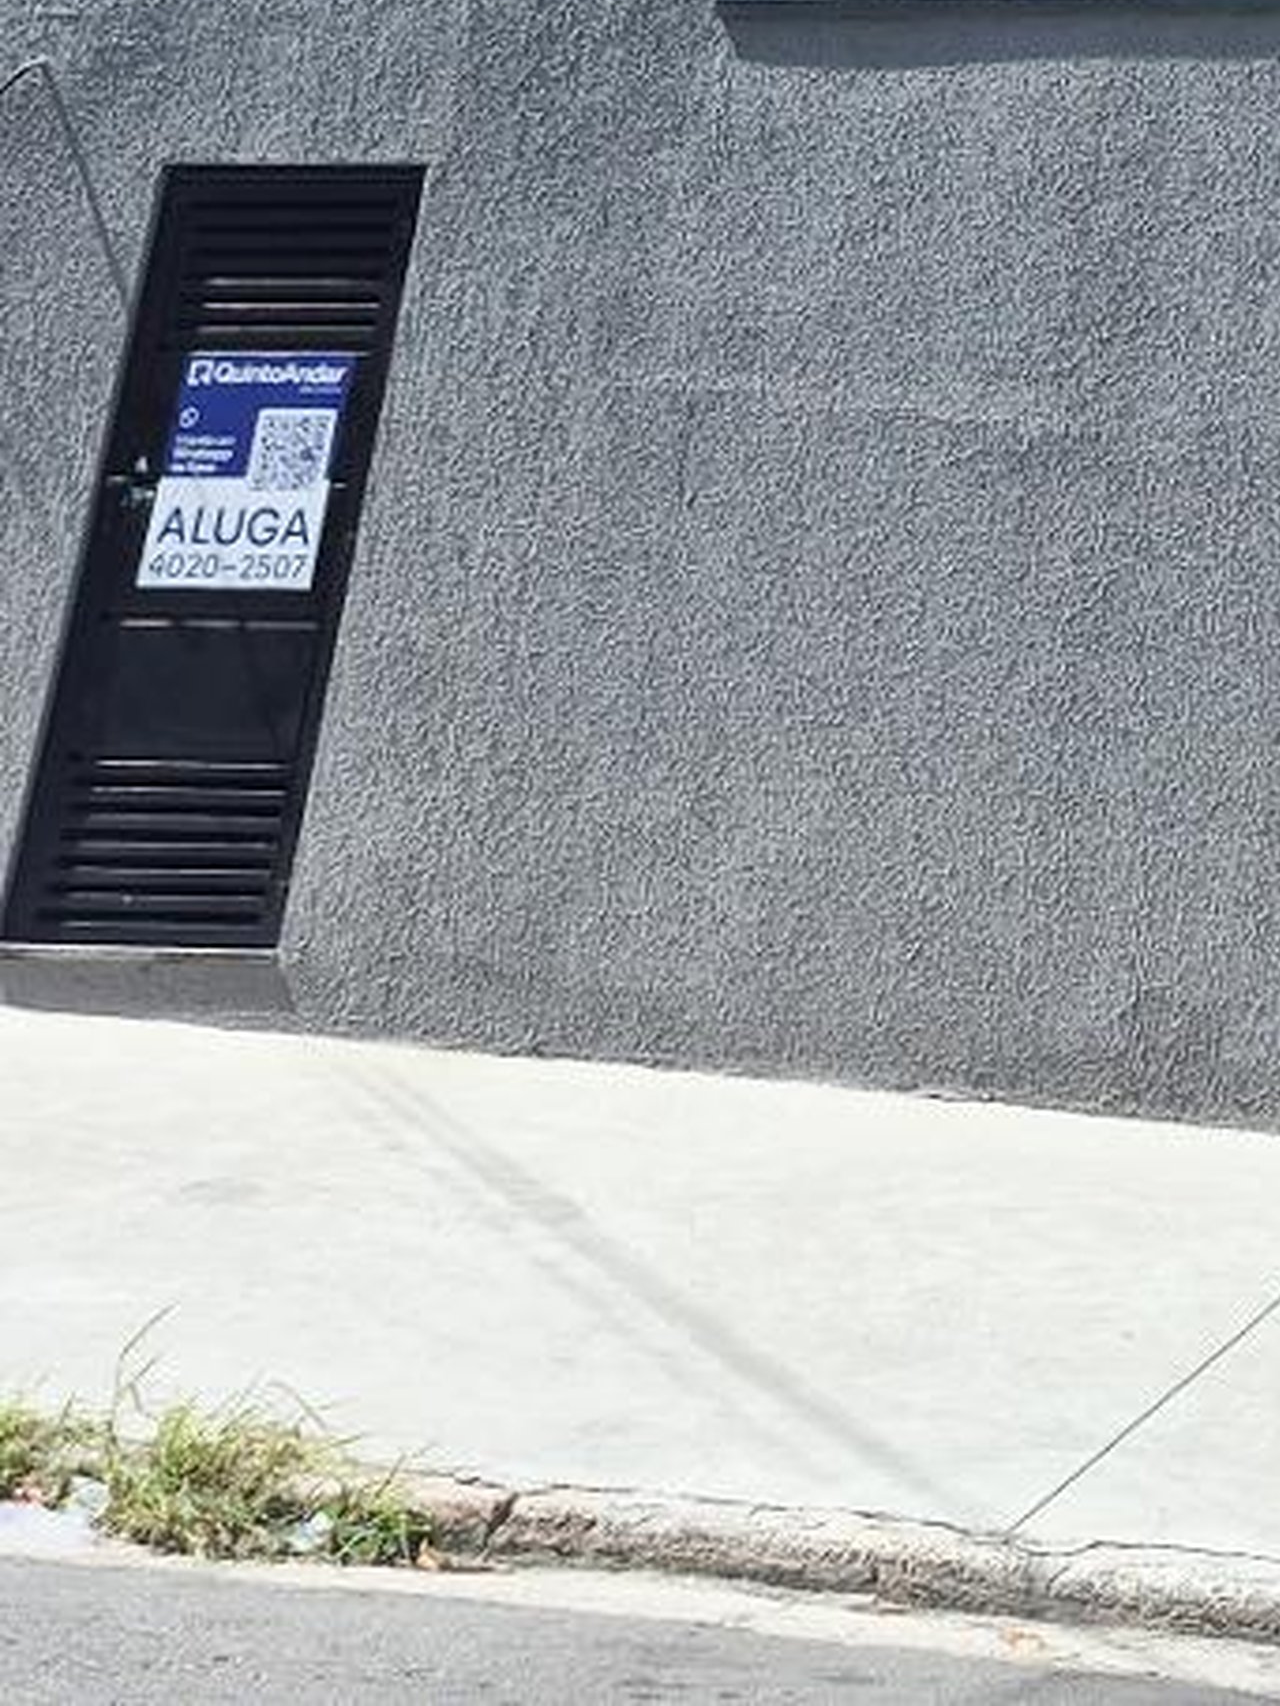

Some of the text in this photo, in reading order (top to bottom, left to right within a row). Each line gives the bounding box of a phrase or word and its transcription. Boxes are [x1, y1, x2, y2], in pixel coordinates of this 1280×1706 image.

[214, 362, 349, 384] QuintoAndar
[157, 506, 309, 546] ALUGA
[149, 553, 307, 578] 4020-2507
